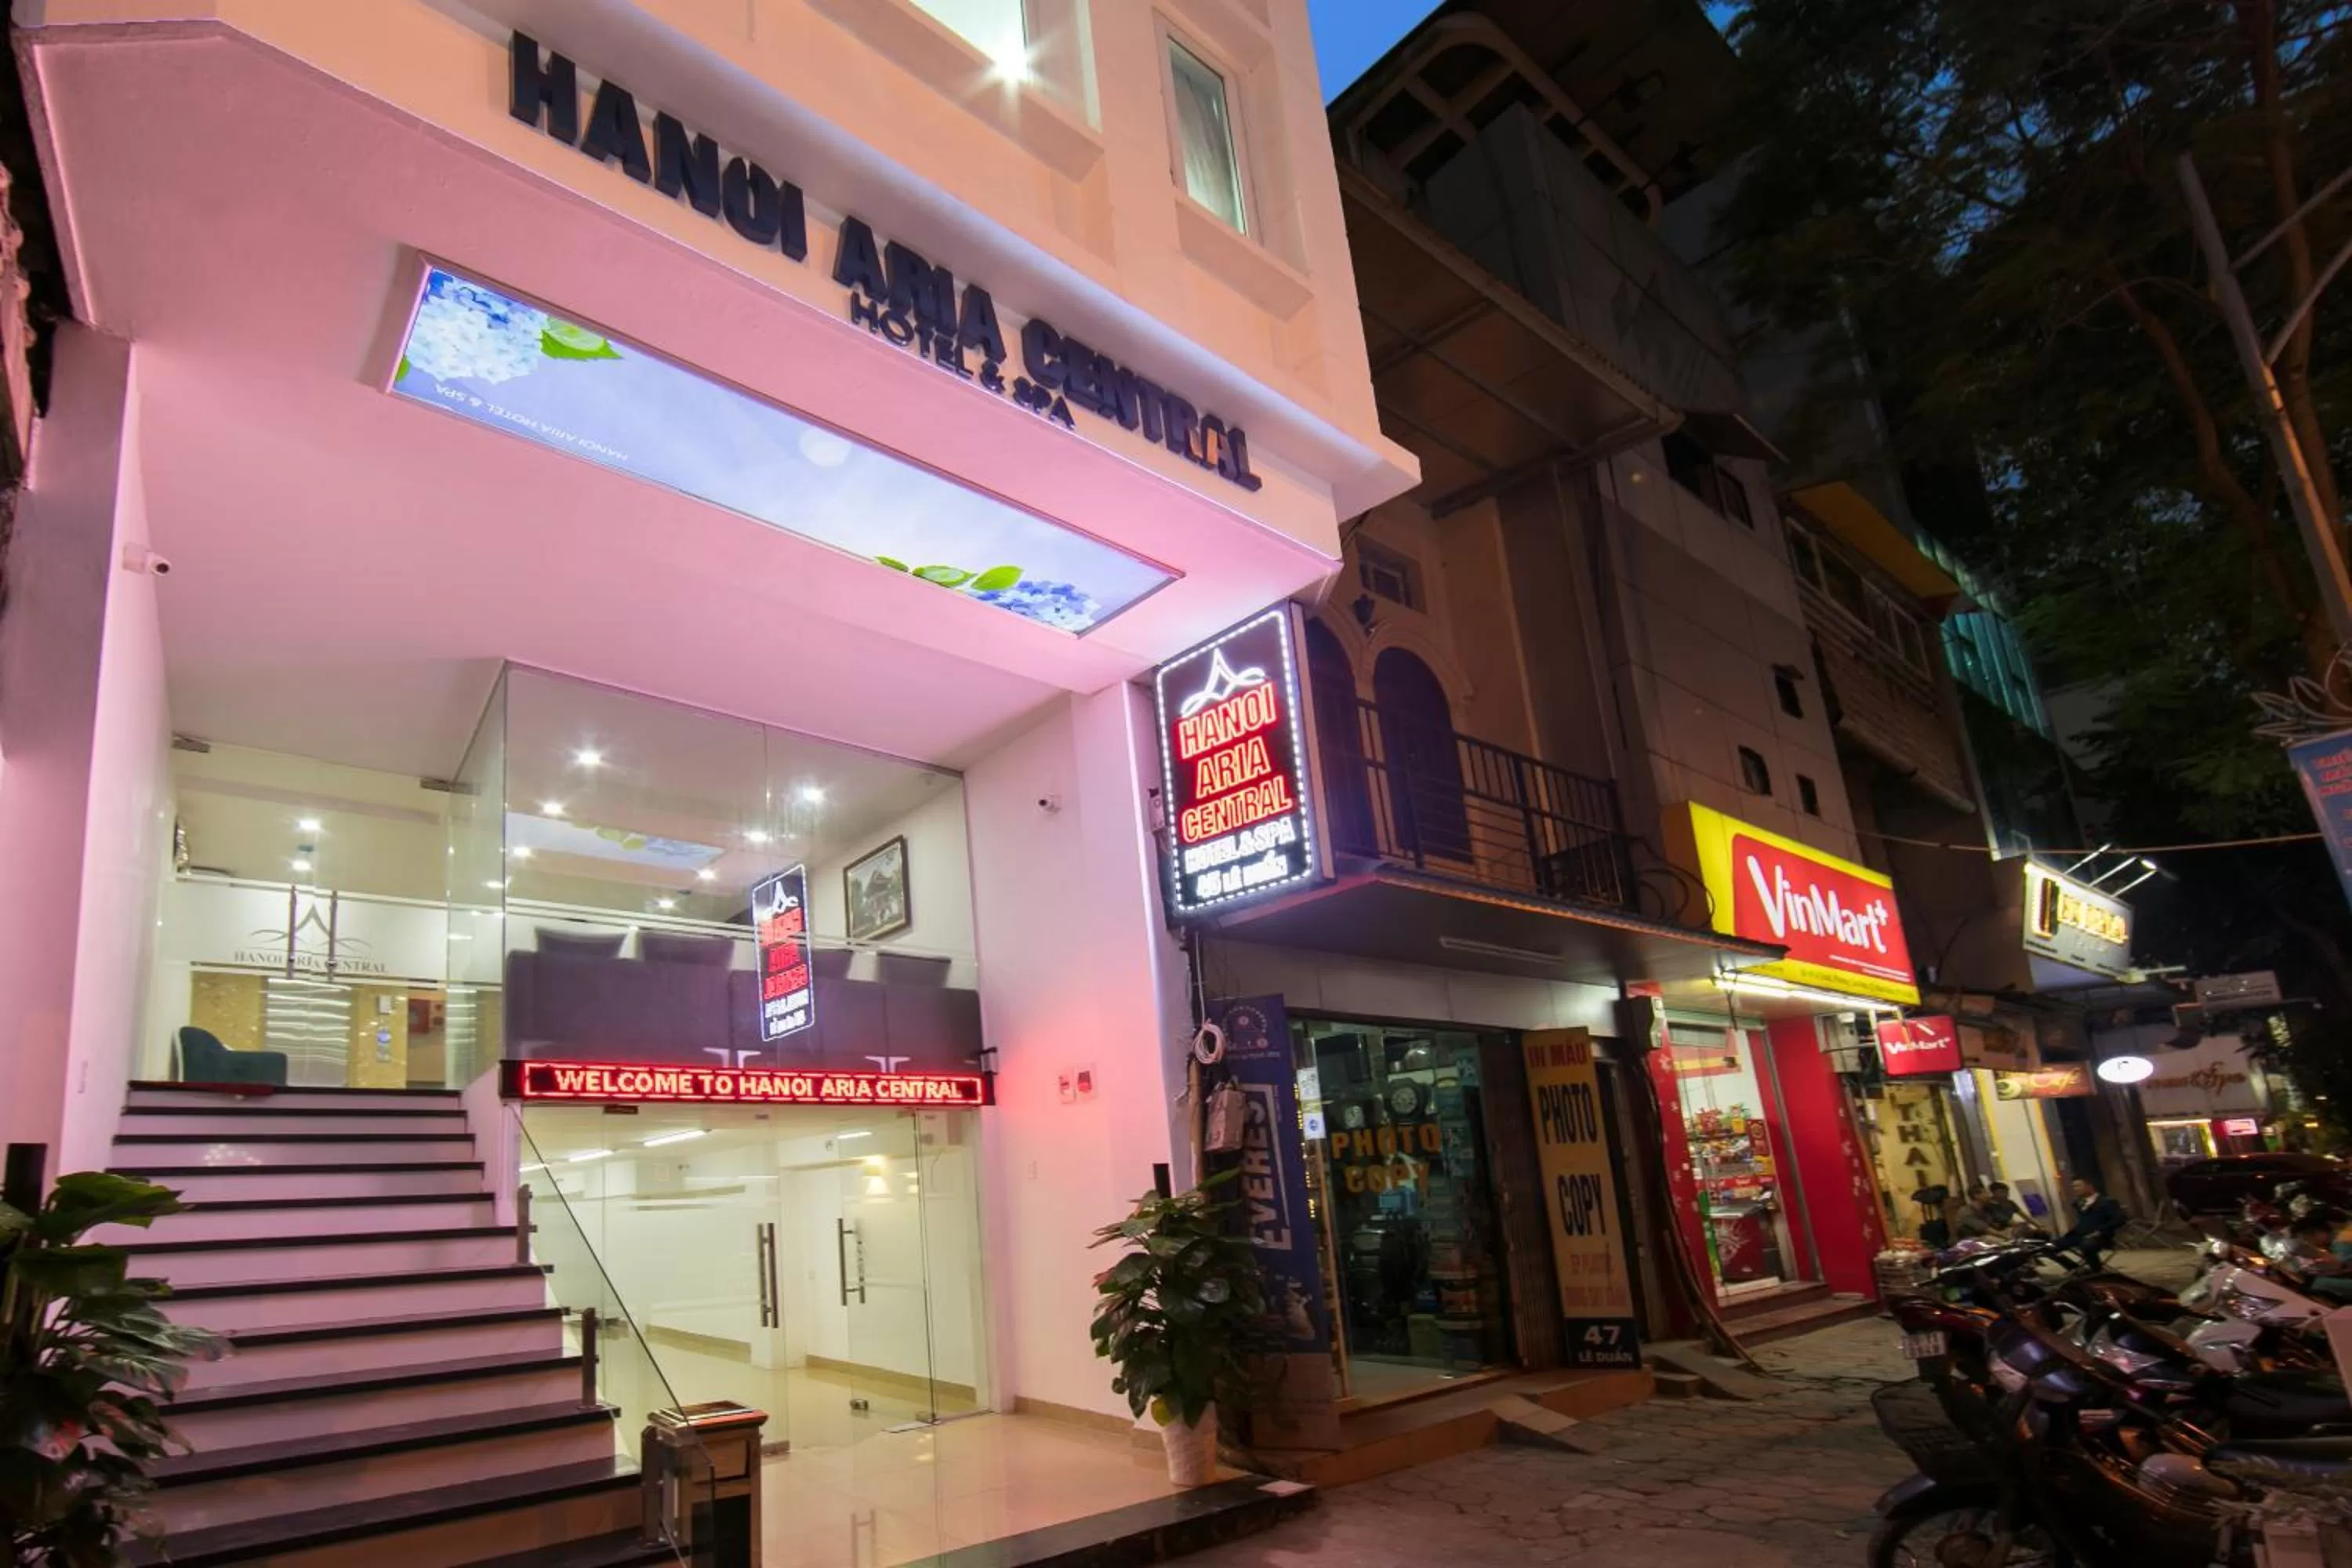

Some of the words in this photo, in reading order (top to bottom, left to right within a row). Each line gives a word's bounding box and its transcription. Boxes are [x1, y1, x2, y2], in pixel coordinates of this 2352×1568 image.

[508, 28, 808, 263] HANOI
[833, 215, 1007, 365] ARIA
[1020, 316, 1263, 493] CENTRAL
[850, 291, 975, 379] HOTEL
[980, 359, 1005, 393] &
[1013, 376, 1076, 430] SPA
[435, 383, 466, 402] SPA
[469, 395, 483, 408] &
[486, 404, 539, 427] HOTEL
[541, 423, 577, 443] ARIA
[578, 438, 628, 460] HANOI
[1178, 681, 1278, 759] HANOI
[1196, 735, 1271, 800] ARIA
[1181, 775, 1294, 843] CENTRAL
[288, 953, 321, 968] RIA
[554, 1069, 694, 1094] WELCOME
[699, 1074, 733, 1094] TO
[739, 1076, 813, 1097] HANOI
[820, 1077, 873, 1098] ARIA
[876, 1080, 963, 1099] CENTRAL
[1539, 1083, 1599, 1145] PHOTO
[1331, 1123, 1442, 1160] PHOTO
[1345, 1163, 1431, 1196] COPY
[1556, 1173, 1607, 1237] COPY
[1583, 1324, 1621, 1346] 47
